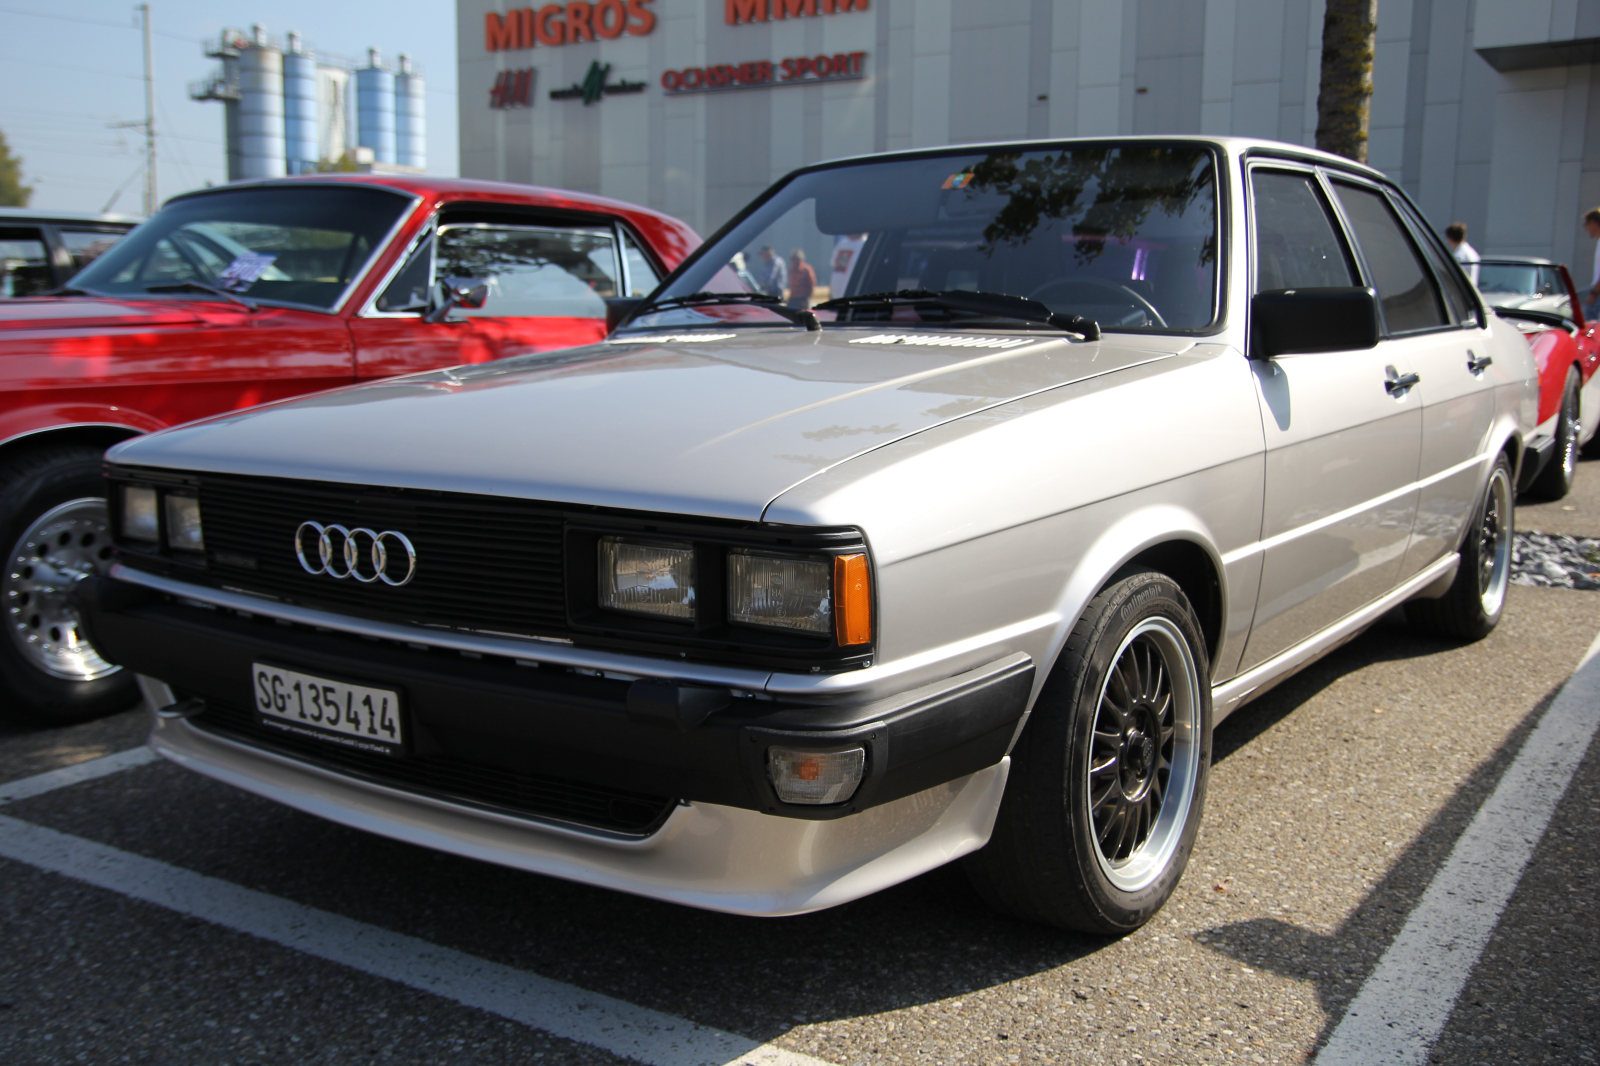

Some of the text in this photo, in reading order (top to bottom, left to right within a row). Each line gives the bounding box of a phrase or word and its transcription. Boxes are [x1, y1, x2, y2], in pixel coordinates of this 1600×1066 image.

[485, 0, 655, 51] MIGROS
[661, 59, 773, 91] OCHSNER
[780, 52, 865, 79] SPORT
